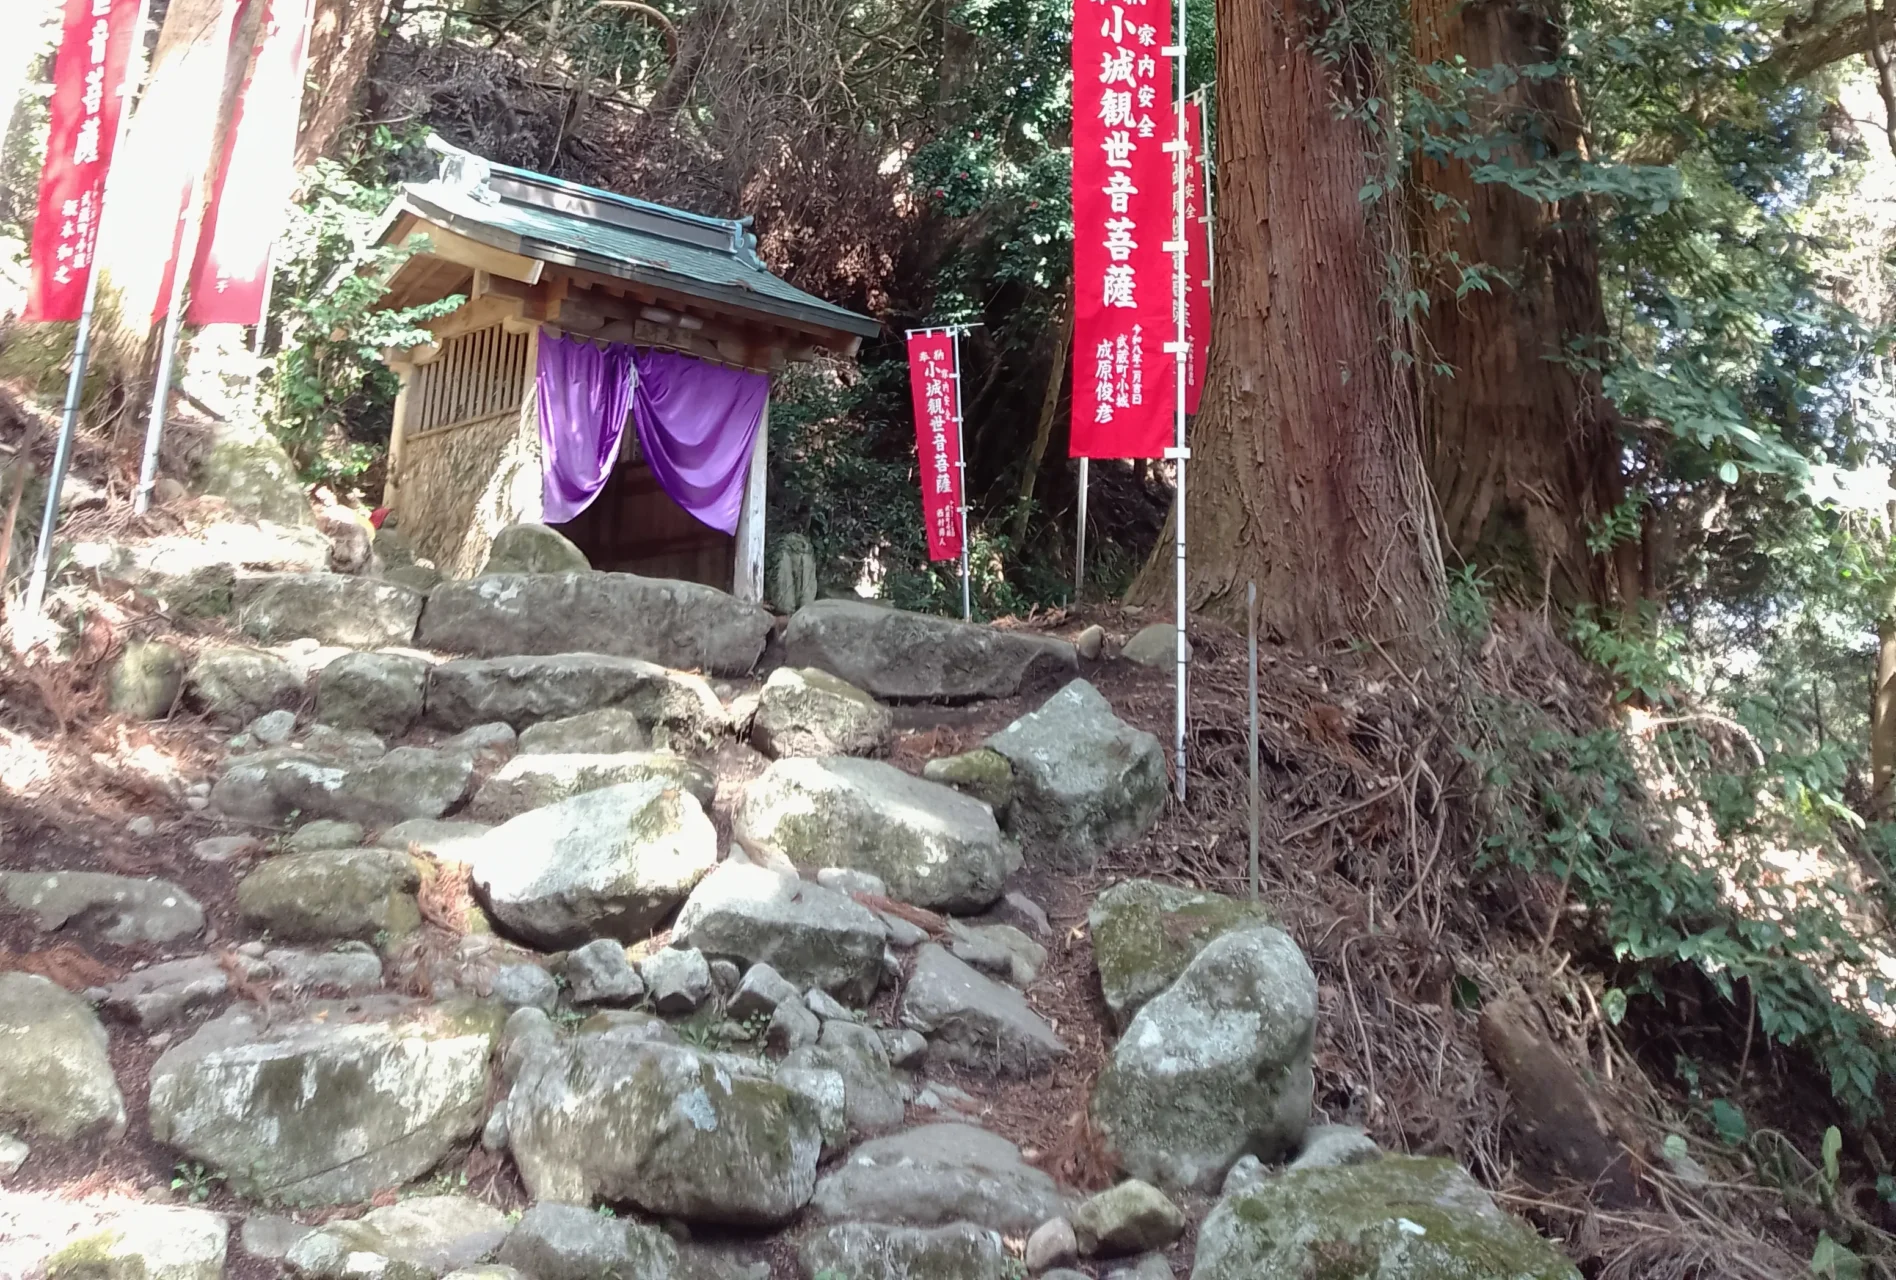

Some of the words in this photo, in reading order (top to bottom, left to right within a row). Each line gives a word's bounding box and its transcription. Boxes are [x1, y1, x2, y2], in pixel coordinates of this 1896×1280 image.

[1138, 24, 1156, 138] 家内安全
[1099, 6, 1138, 308] 小城観世音菩薩
[919, 350, 944, 362] 奉納
[1094, 337, 1115, 424] 成原俊彦
[1115, 333, 1130, 408] 武蔵町小城
[924, 361, 952, 494] 小城観世音菩薩
